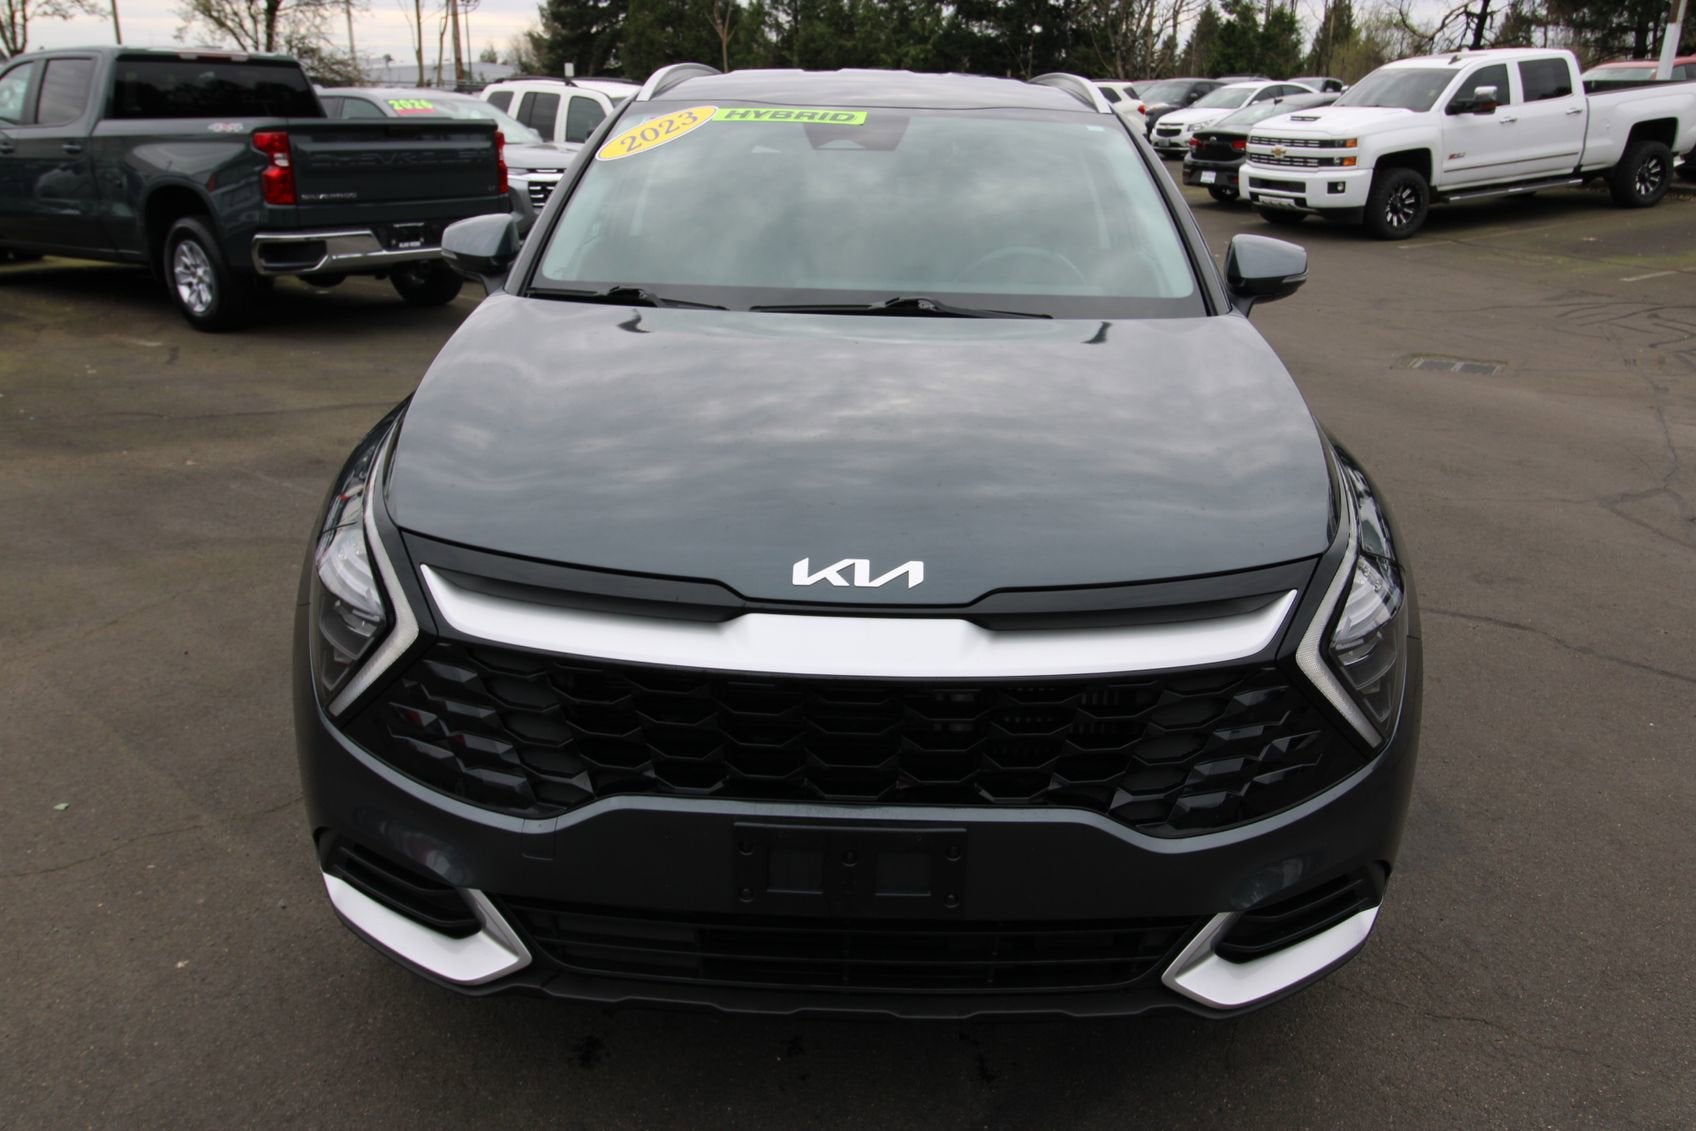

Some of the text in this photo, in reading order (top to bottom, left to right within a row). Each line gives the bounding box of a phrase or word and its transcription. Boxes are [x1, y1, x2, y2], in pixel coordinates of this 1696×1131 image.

[618, 110, 699, 153] 2023
[723, 109, 857, 123] HYBRID
[792, 557, 924, 589] KIA
